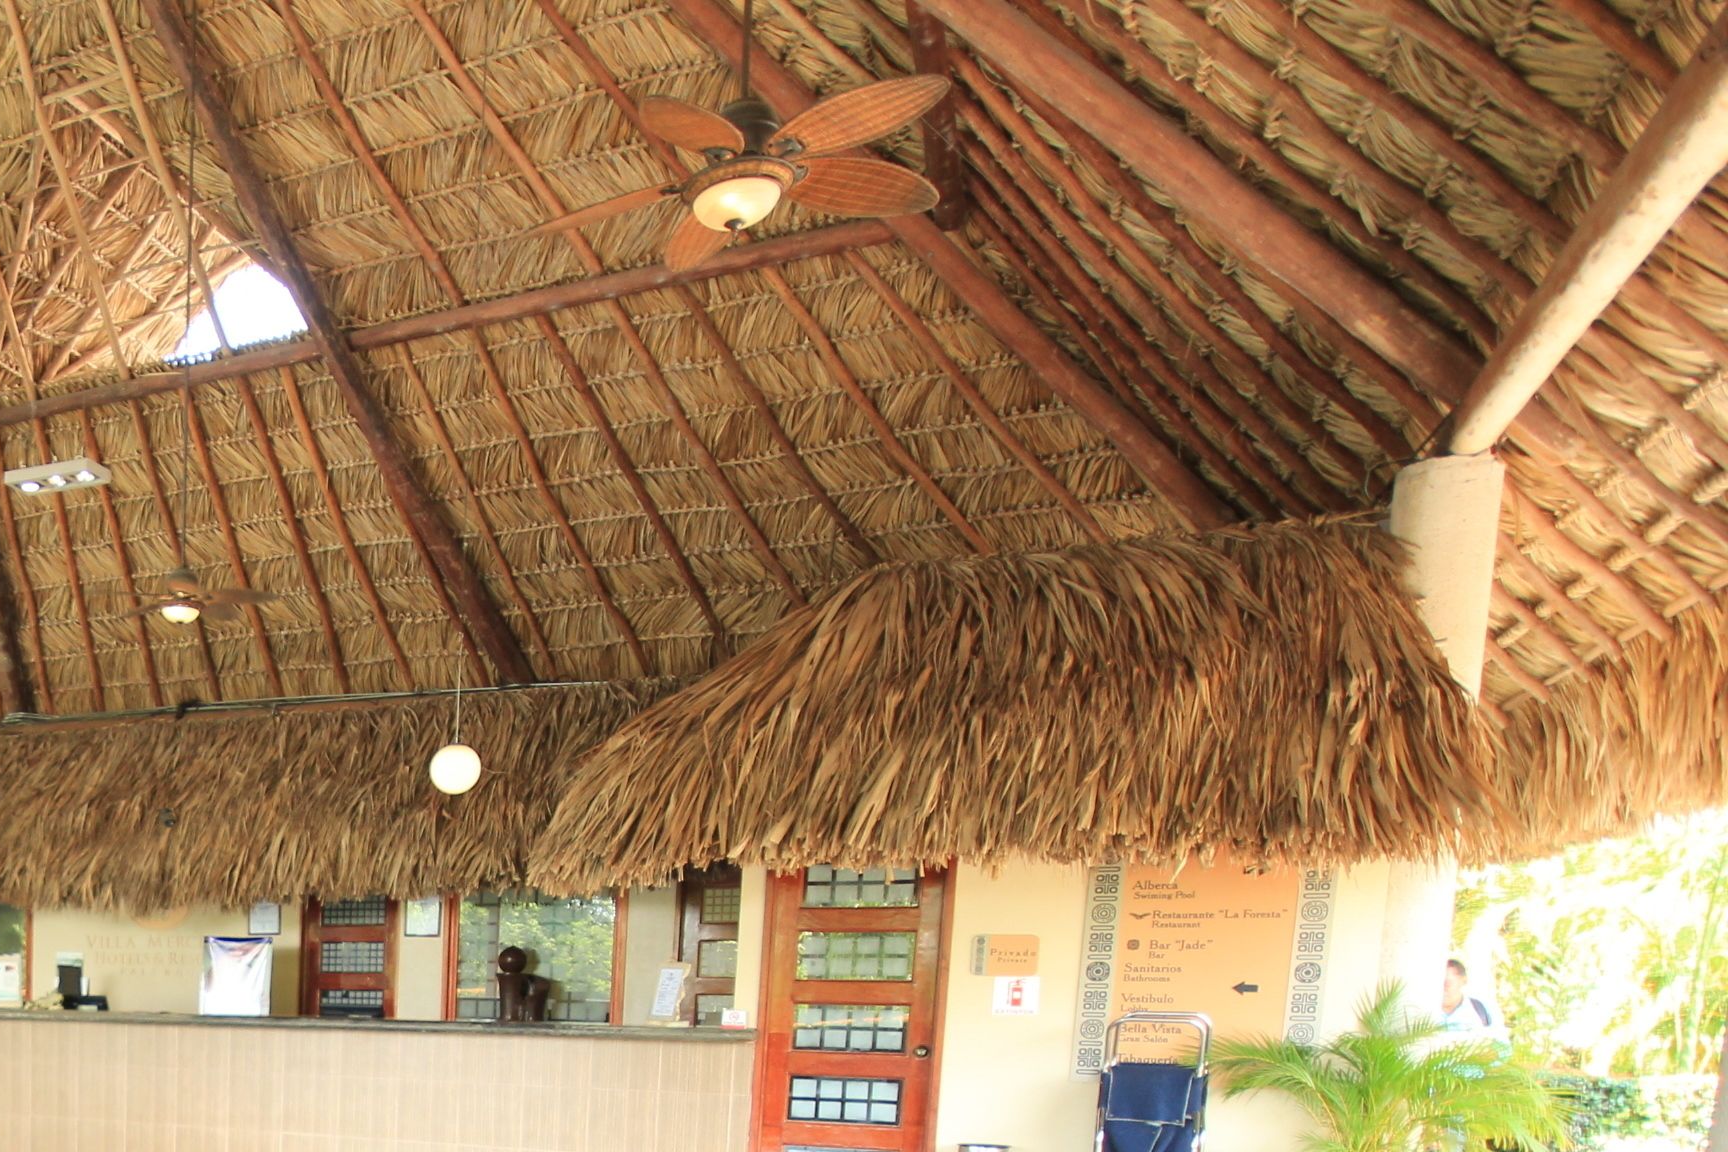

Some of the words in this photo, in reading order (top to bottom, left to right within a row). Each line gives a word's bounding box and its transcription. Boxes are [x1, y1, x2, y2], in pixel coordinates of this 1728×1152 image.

[1132, 880, 1178, 891] Alberca
[1133, 890, 1173, 900] Swiming
[1174, 890, 1196, 899] Pool
[1152, 910, 1215, 920] Restaurante
[1151, 920, 1201, 929] Restaurant
[85, 934, 136, 949] VILLA
[1149, 939, 1172, 950] Bar
[1148, 951, 1165, 959] Bar
[1123, 963, 1183, 973] Sanitarios
[1123, 973, 1171, 983] Bathrooms
[1119, 1023, 1148, 1034] Bella
[1151, 1023, 1183, 1034] Vista
